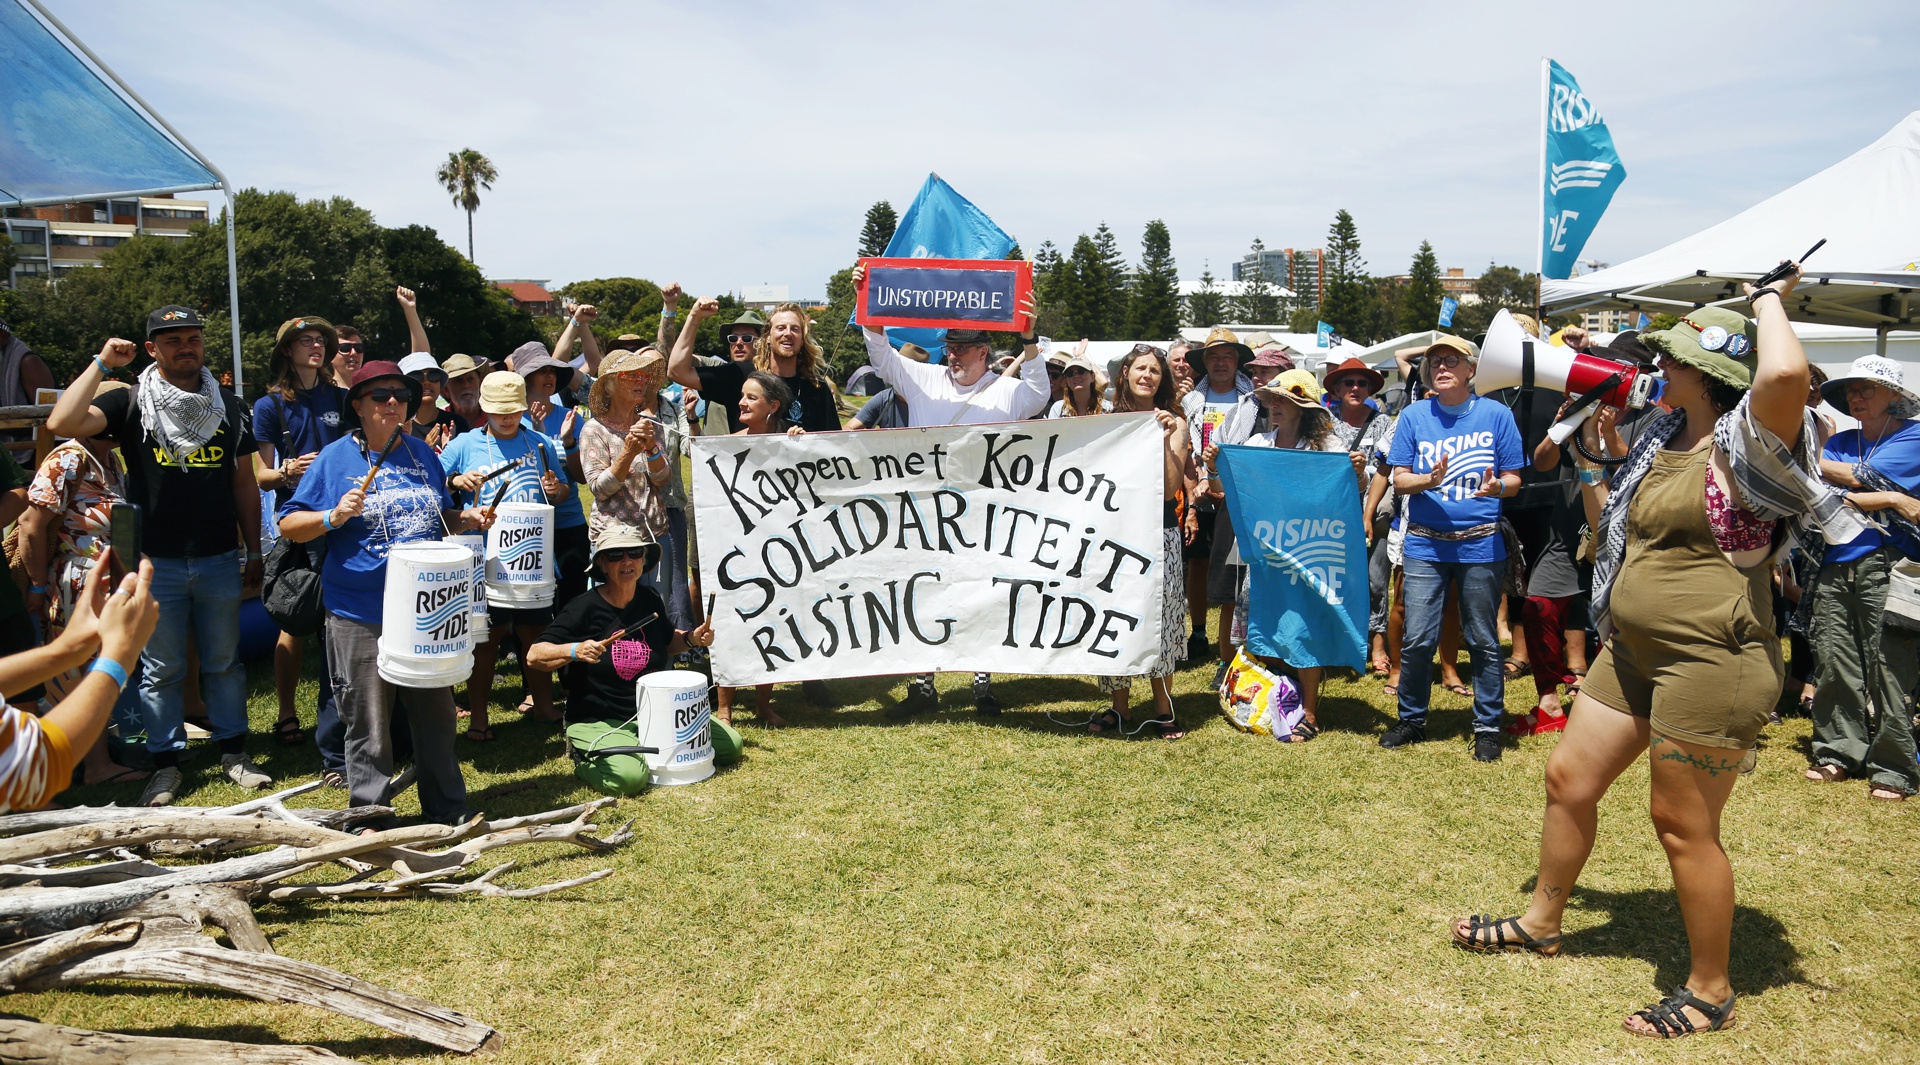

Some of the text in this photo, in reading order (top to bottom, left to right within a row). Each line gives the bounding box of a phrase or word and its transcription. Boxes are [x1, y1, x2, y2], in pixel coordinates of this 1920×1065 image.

[878, 286, 1003, 309] UNSTOPPABLE
[1418, 431, 1494, 470] RISING
[706, 433, 1120, 536] Kappen met Kolon
[501, 515, 544, 524] ADELAIDE
[500, 527, 543, 547] RISING
[1253, 519, 1346, 553] RISING
[507, 551, 543, 570] TIDE
[417, 568, 470, 582] ADELAIDE
[497, 572, 543, 581] DRUMLINE
[416, 581, 469, 613] RISING
[428, 611, 468, 641] TIDE
[414, 639, 468, 655] DRUMLINE
